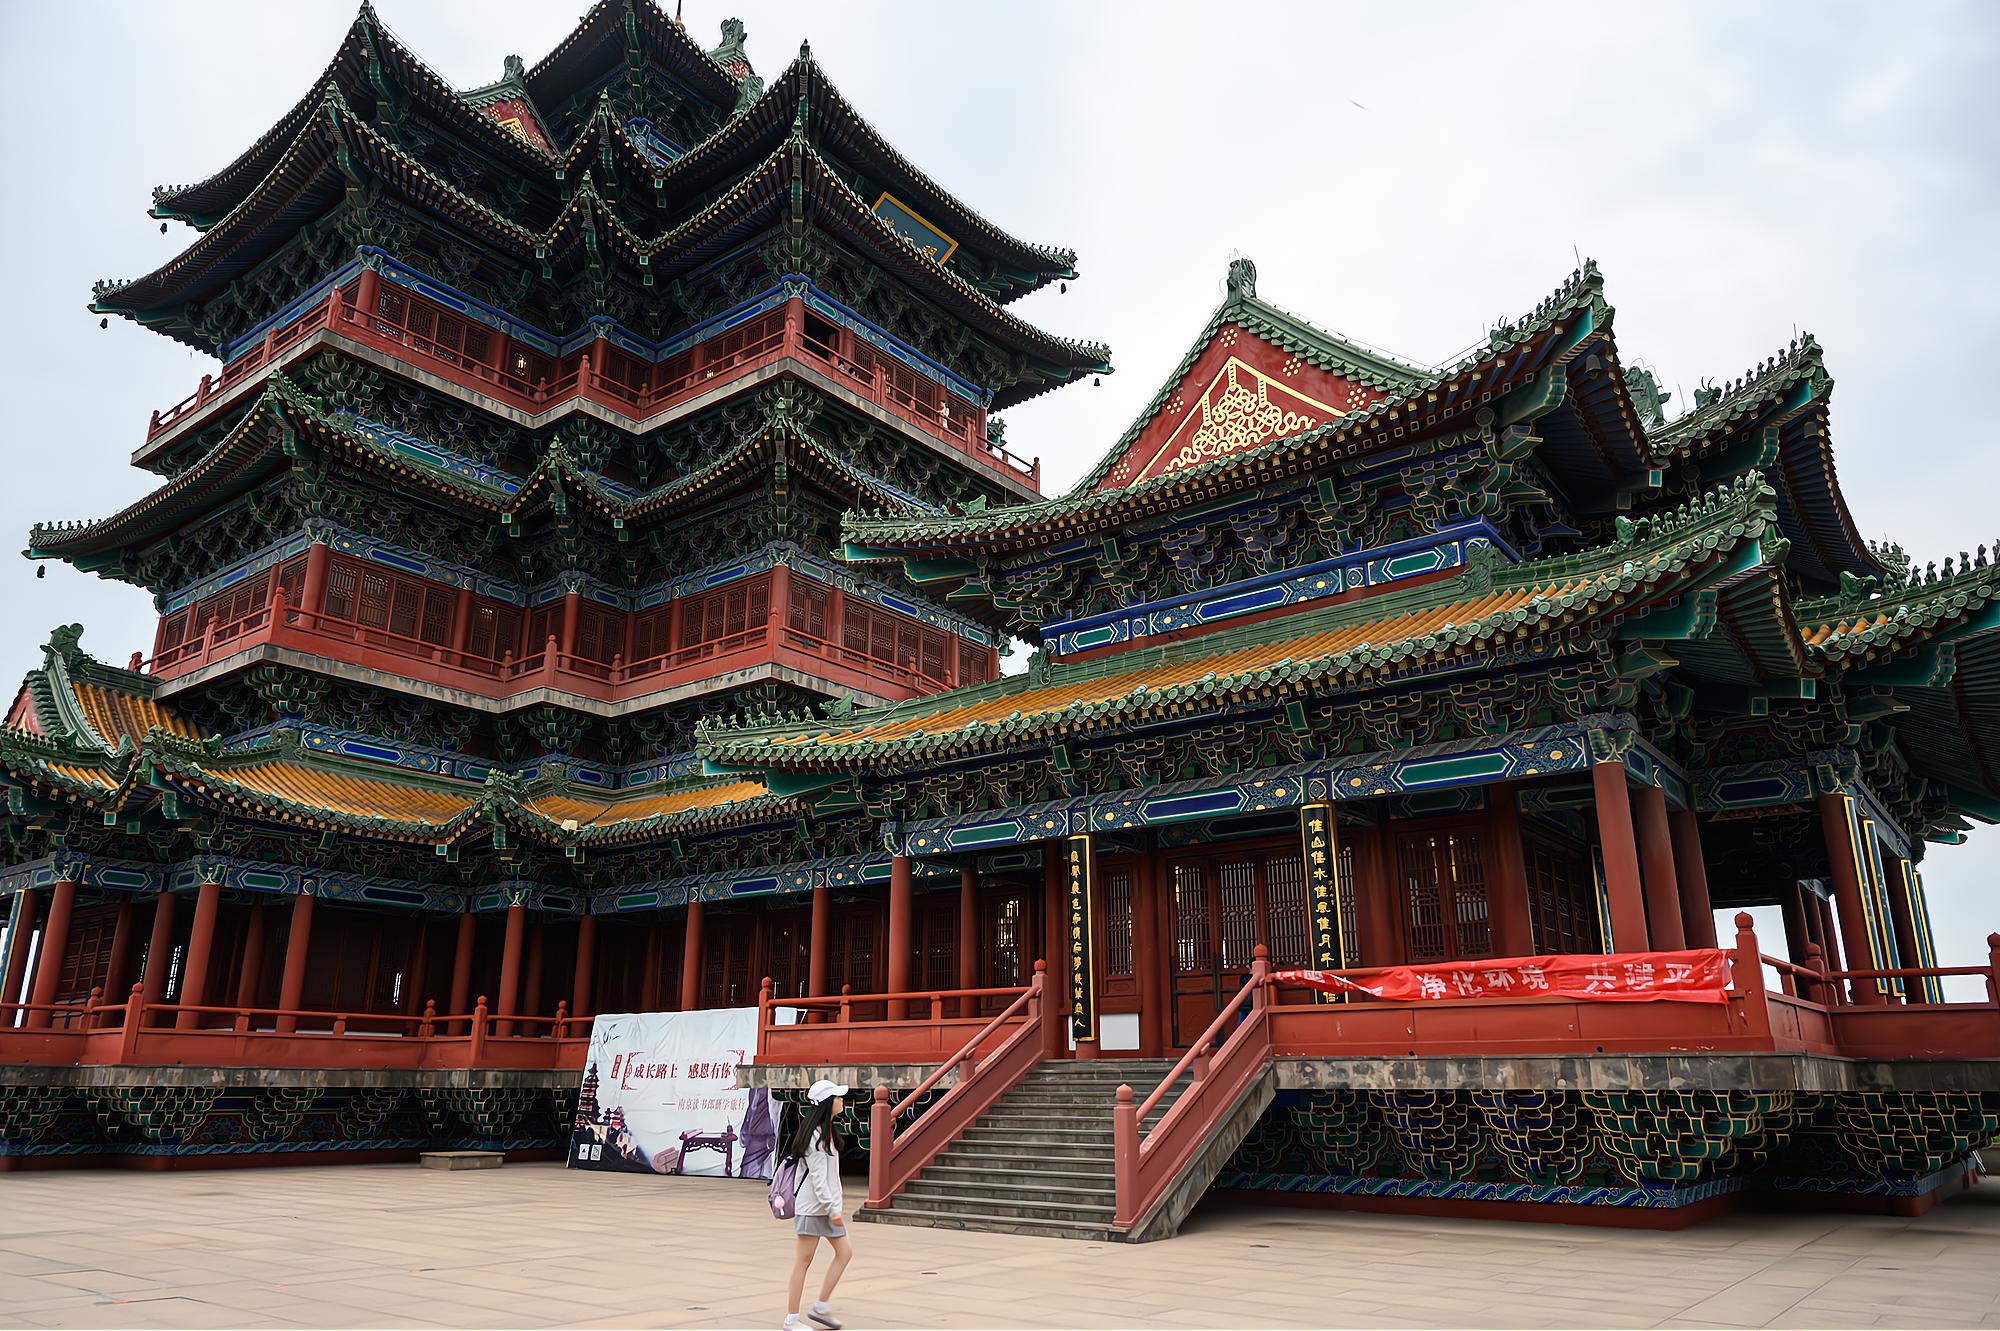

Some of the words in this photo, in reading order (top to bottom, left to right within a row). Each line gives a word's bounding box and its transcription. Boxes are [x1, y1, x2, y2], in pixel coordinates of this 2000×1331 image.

[1416, 965, 1549, 999] 净化环境
[634, 1063, 678, 1080] 成长路上
[688, 1062, 732, 1080] 感恩有你
